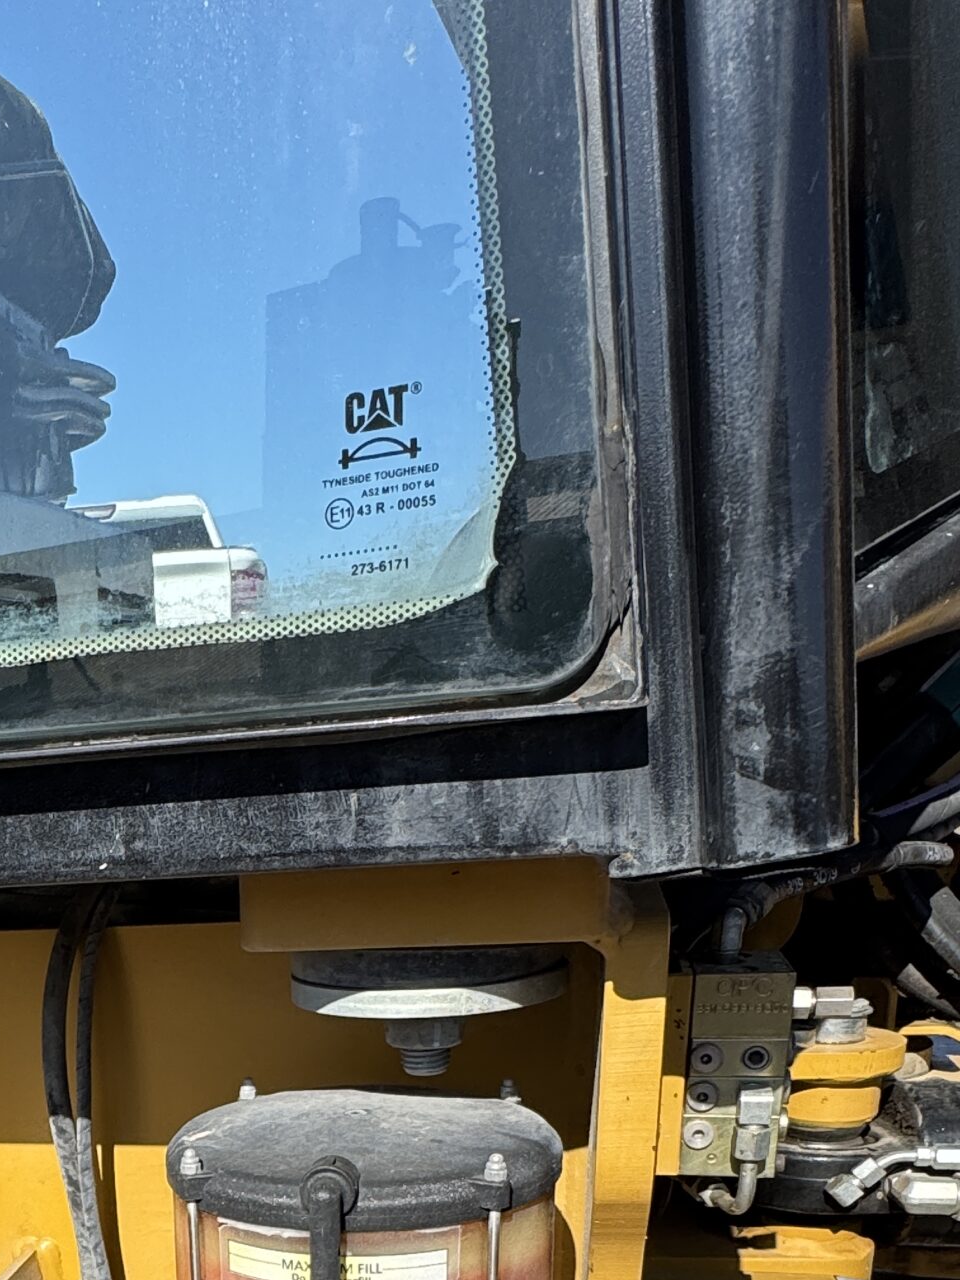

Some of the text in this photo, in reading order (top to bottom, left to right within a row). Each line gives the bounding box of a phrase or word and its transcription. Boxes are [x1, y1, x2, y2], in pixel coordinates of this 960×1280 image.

[345, 383, 409, 434] CAT
[322, 462, 440, 489] TYNESIDE TOUGHENED
[361, 487, 380, 498] AS2
[382, 484, 399, 495] M11
[402, 480, 422, 492] DOT
[357, 504, 372, 517] 43
[376, 502, 385, 514] R
[397, 494, 437, 511] 00055
[351, 557, 409, 576] 273-6171
[281, 1258, 383, 1275] MAXM FILL
